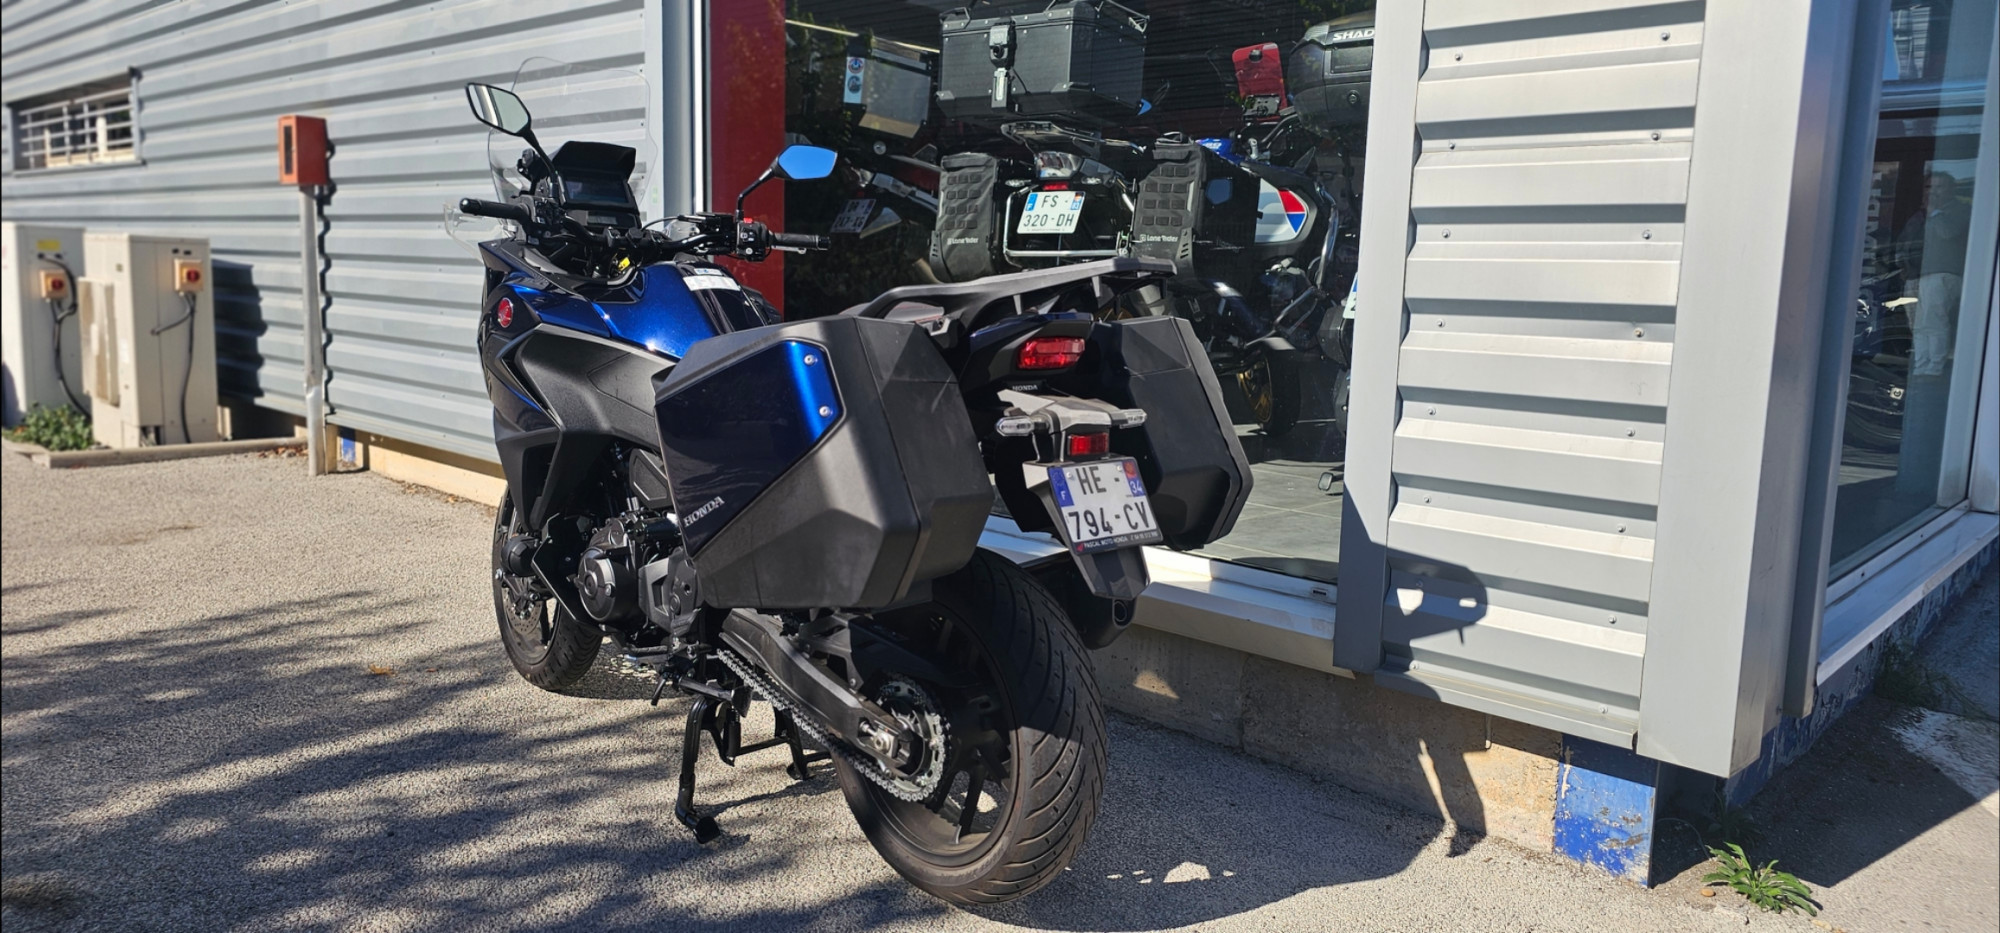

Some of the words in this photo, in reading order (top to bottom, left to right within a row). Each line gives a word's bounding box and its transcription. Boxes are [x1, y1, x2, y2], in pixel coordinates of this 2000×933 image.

[1333, 28, 1375, 41] SHAD
[1041, 195, 1059, 208] FS
[1075, 466, 1107, 496] HE
[1131, 480, 1143, 495] 34
[1060, 490, 1066, 500] F
[683, 496, 725, 527] HONDA
